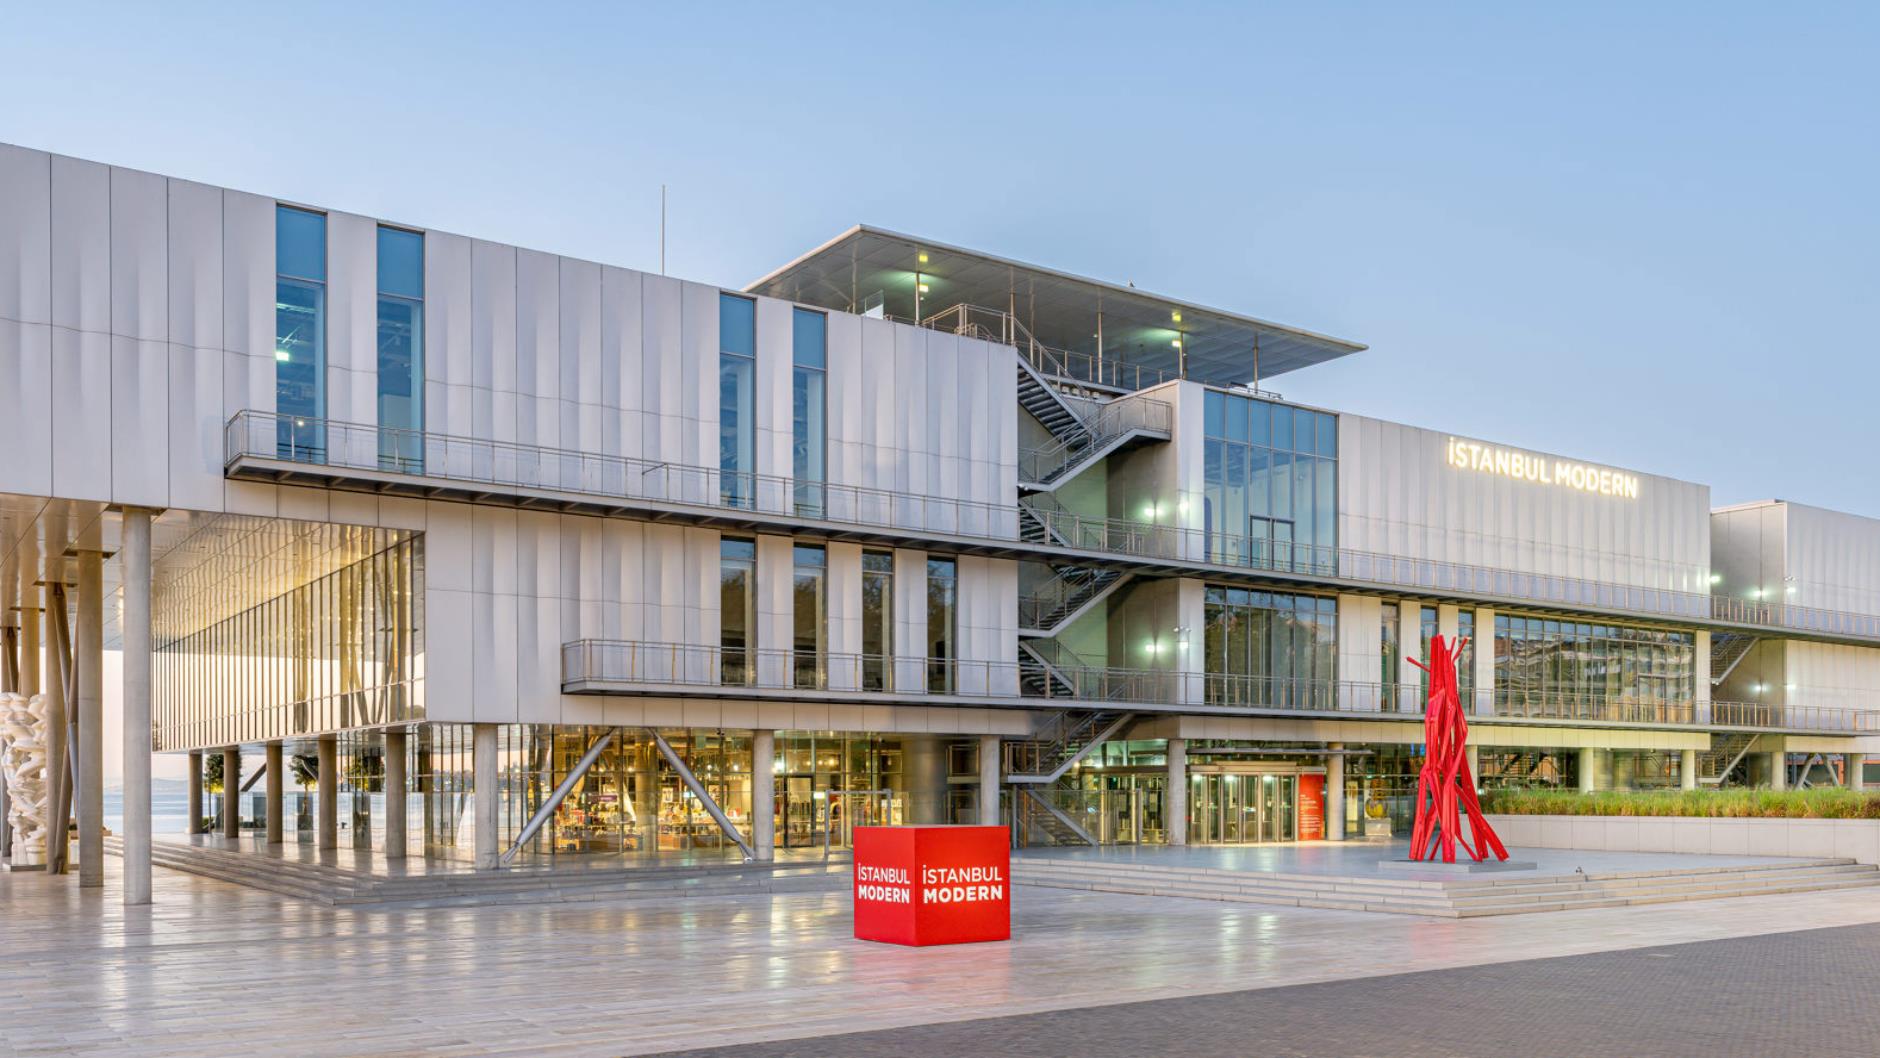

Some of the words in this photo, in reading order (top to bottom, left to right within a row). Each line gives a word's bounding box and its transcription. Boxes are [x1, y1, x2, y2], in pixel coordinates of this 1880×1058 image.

[1555, 463, 1638, 499] MODERN
[858, 885, 910, 903] MODERN
[923, 885, 1002, 904] MODERN
